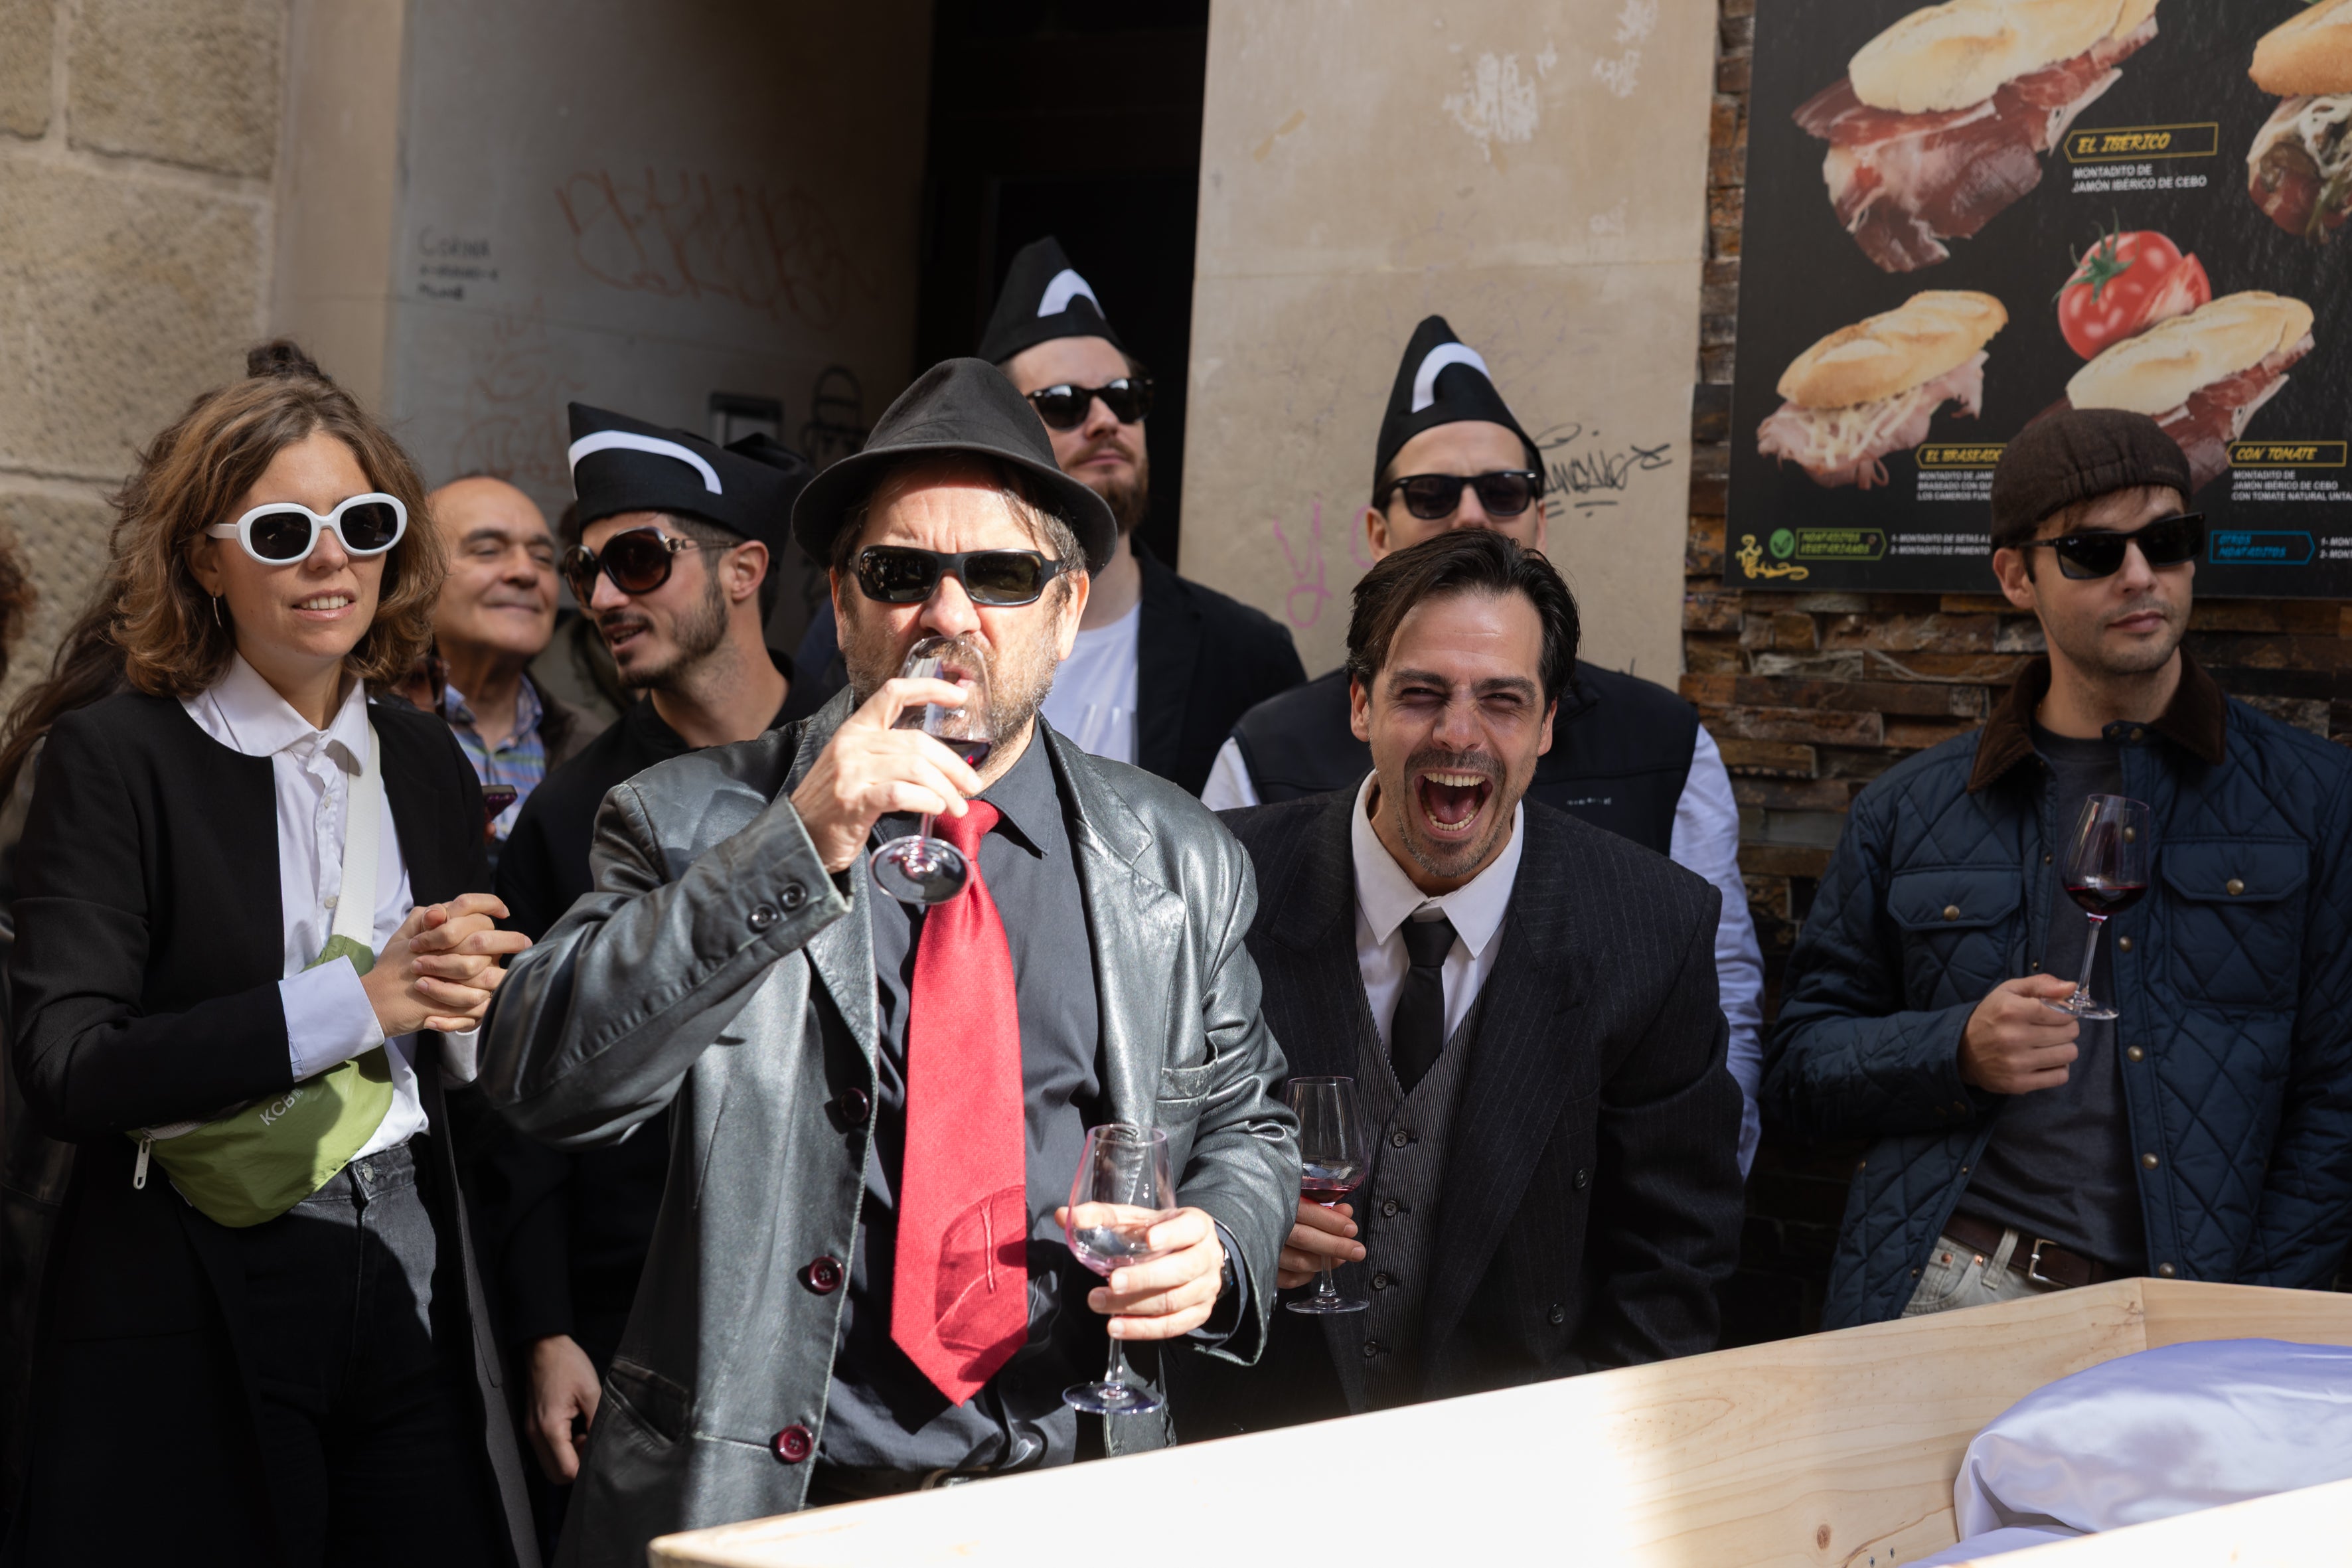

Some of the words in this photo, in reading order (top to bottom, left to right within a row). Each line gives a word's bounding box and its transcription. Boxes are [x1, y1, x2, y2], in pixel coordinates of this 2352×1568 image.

[2077, 136, 2097, 154] EL
[2073, 165, 2136, 179] MONTADITO
[2136, 163, 2153, 176] DE
[2157, 176, 2173, 189] DE
[2174, 175, 2207, 188] CEBO
[2235, 447, 2266, 461] CON
[2267, 446, 2318, 461] TOMATE
[1917, 471, 1962, 481] MONTADITO
[1963, 471, 1974, 481] DE
[2233, 470, 2282, 480] MONTADITO
[2283, 470, 2296, 480] DE
[2299, 480, 2312, 491] DE
[2313, 480, 2339, 491] CEBO
[2231, 491, 2251, 501] CON
[2252, 491, 2286, 501] TOMATE
[2287, 491, 2327, 501] NATURAL
[2329, 536, 2352, 546] MON
[2329, 549, 2352, 559] MON
